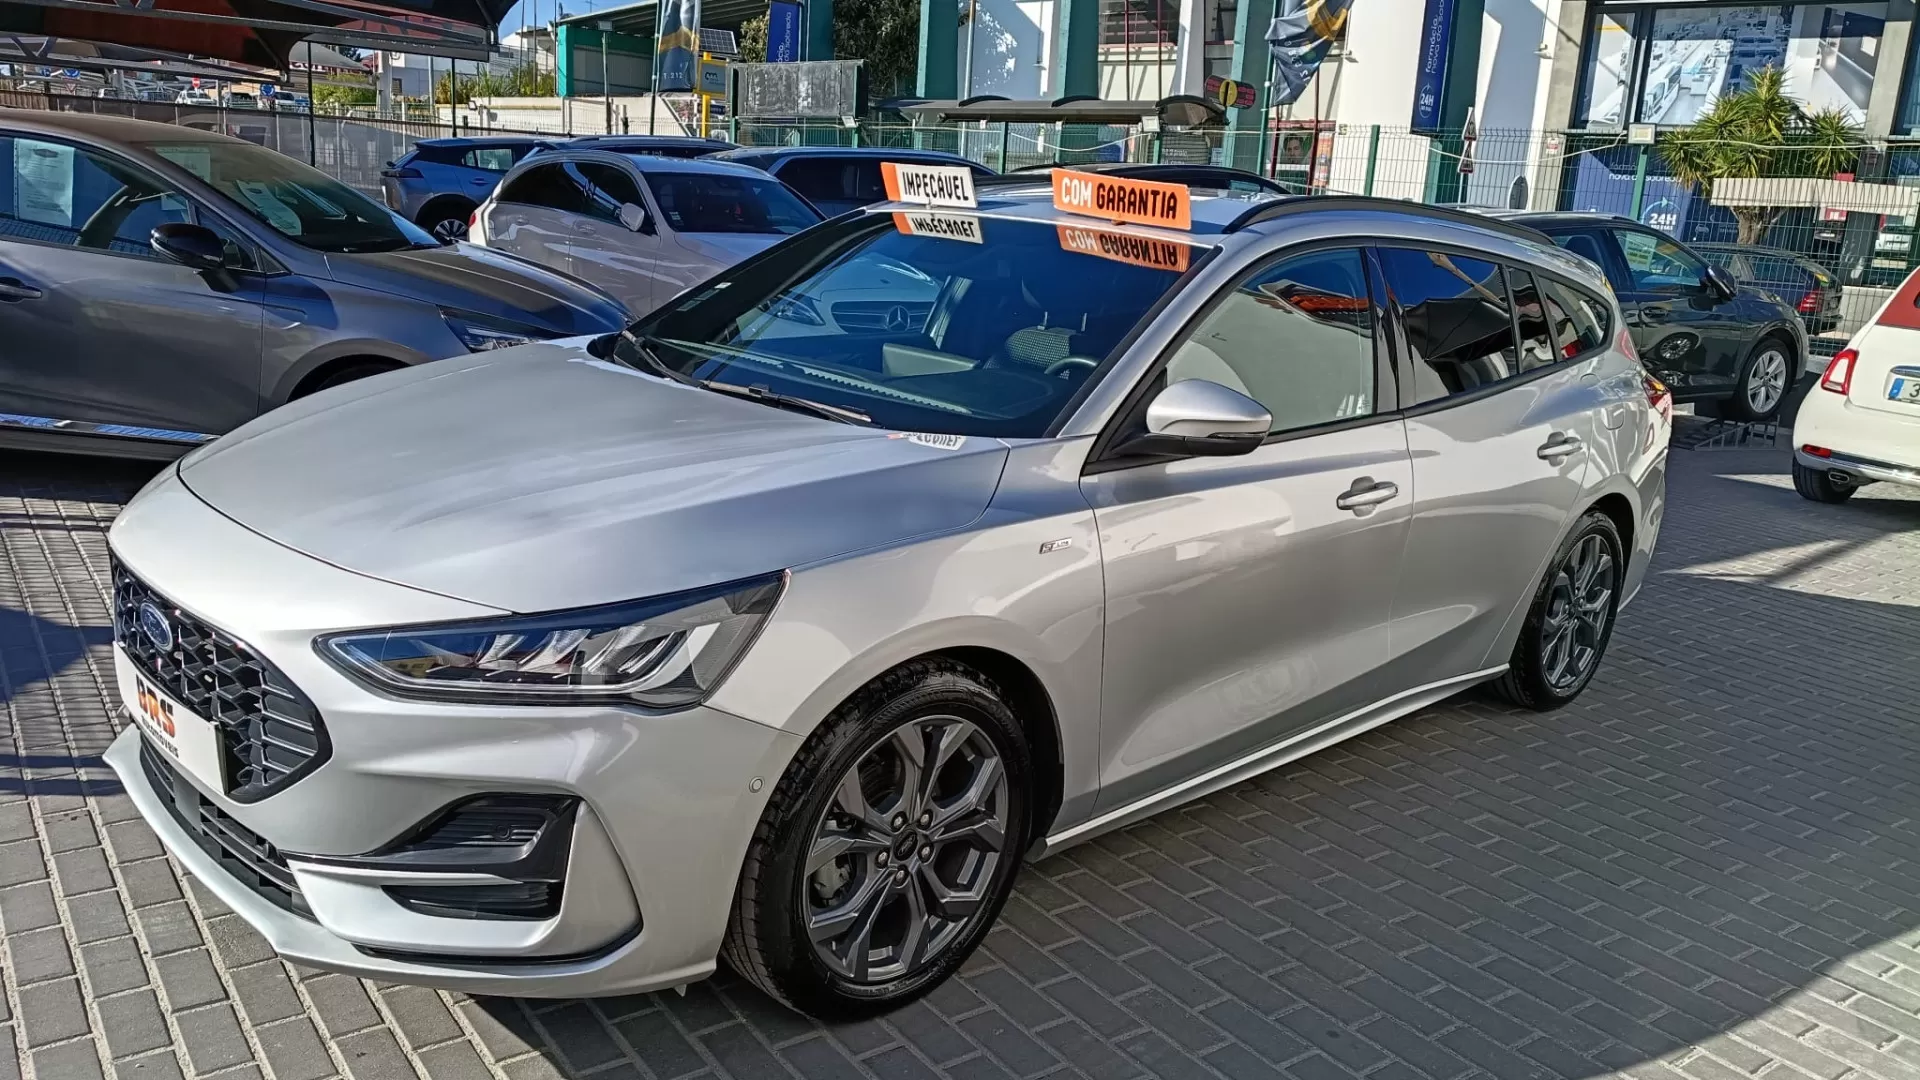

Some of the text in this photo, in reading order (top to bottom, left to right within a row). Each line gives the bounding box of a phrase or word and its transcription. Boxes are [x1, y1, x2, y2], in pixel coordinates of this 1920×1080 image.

[1431, 44, 1440, 74] nova
[1436, 24, 1443, 42] da
[1420, 93, 1435, 107] 24H
[902, 171, 969, 200] IMPECÁVEL
[1061, 176, 1178, 220] COM GARANTIA
[1648, 213, 1677, 226] 24H
